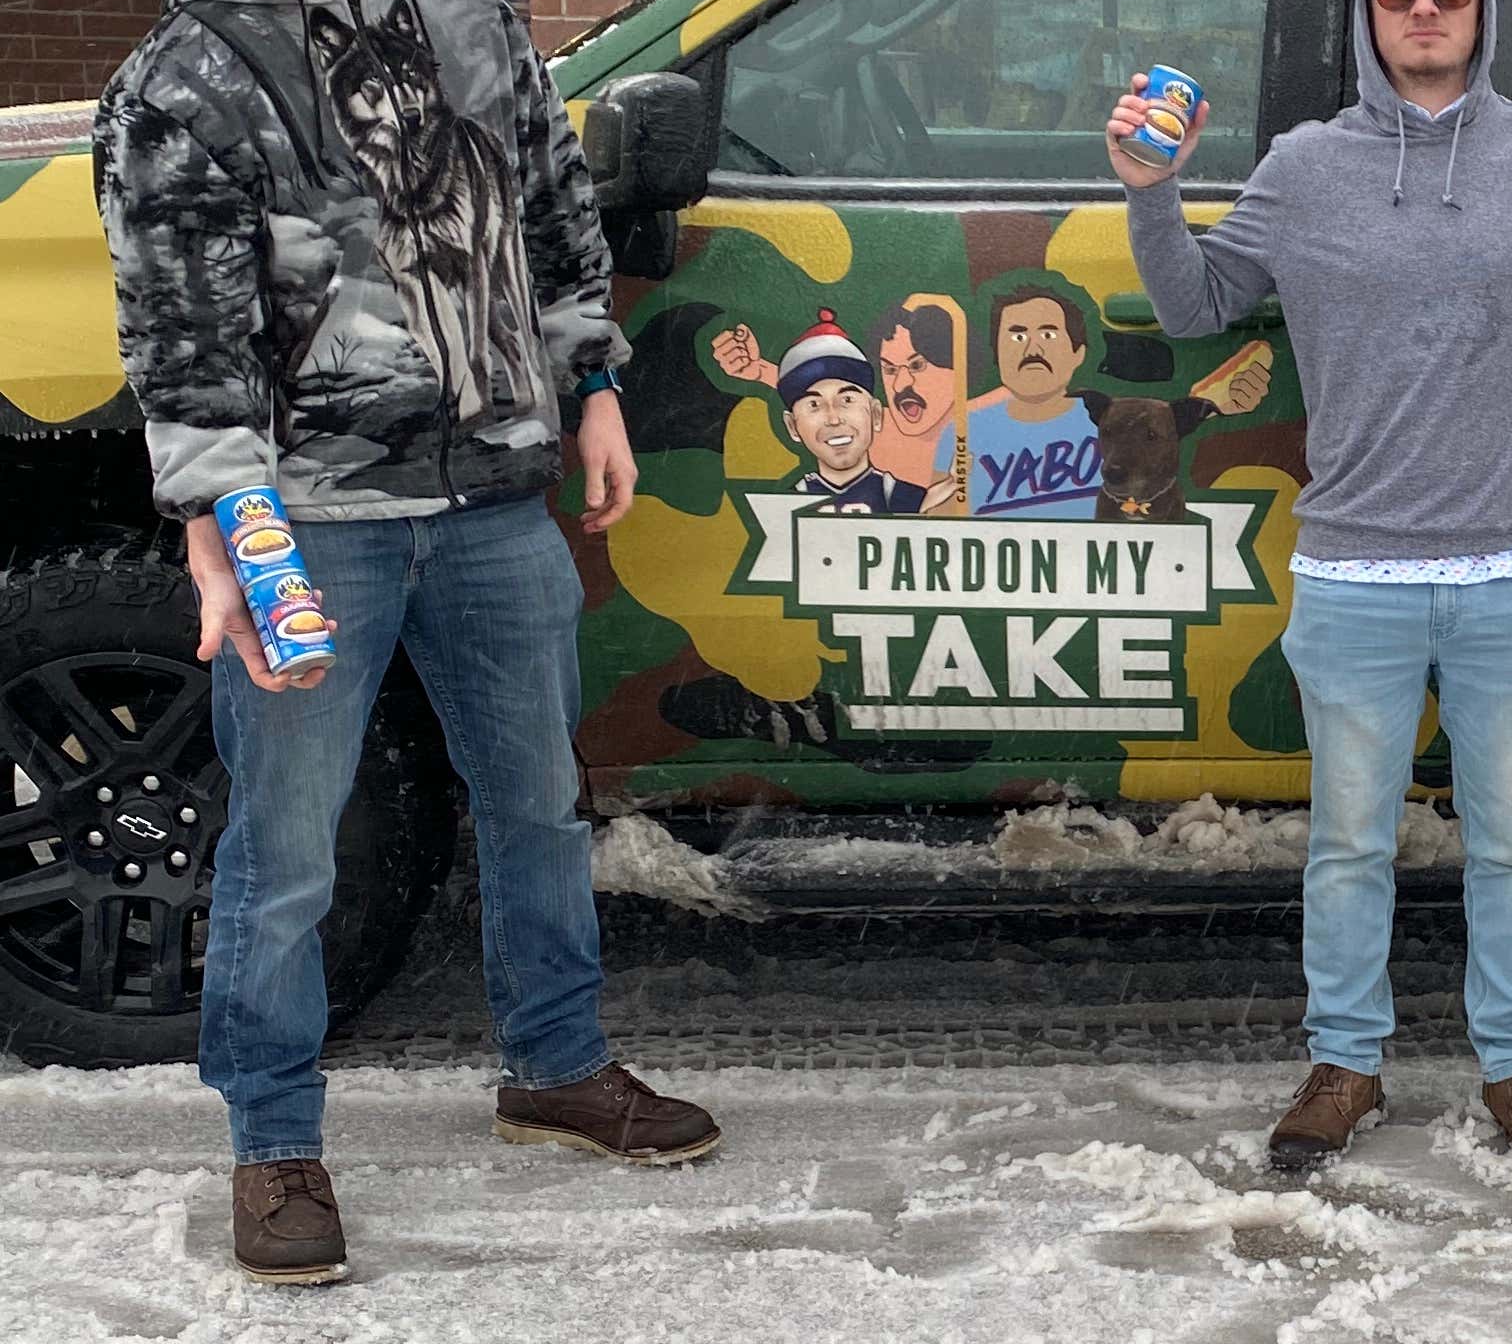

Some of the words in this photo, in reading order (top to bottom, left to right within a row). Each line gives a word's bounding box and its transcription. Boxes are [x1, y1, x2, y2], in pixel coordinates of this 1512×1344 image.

[956, 435, 967, 503] CARSTICK
[979, 435, 1102, 504] YABO
[857, 535, 1058, 594] PARDON
[1086, 539, 1155, 595] MY
[831, 612, 1174, 699] TAKE
